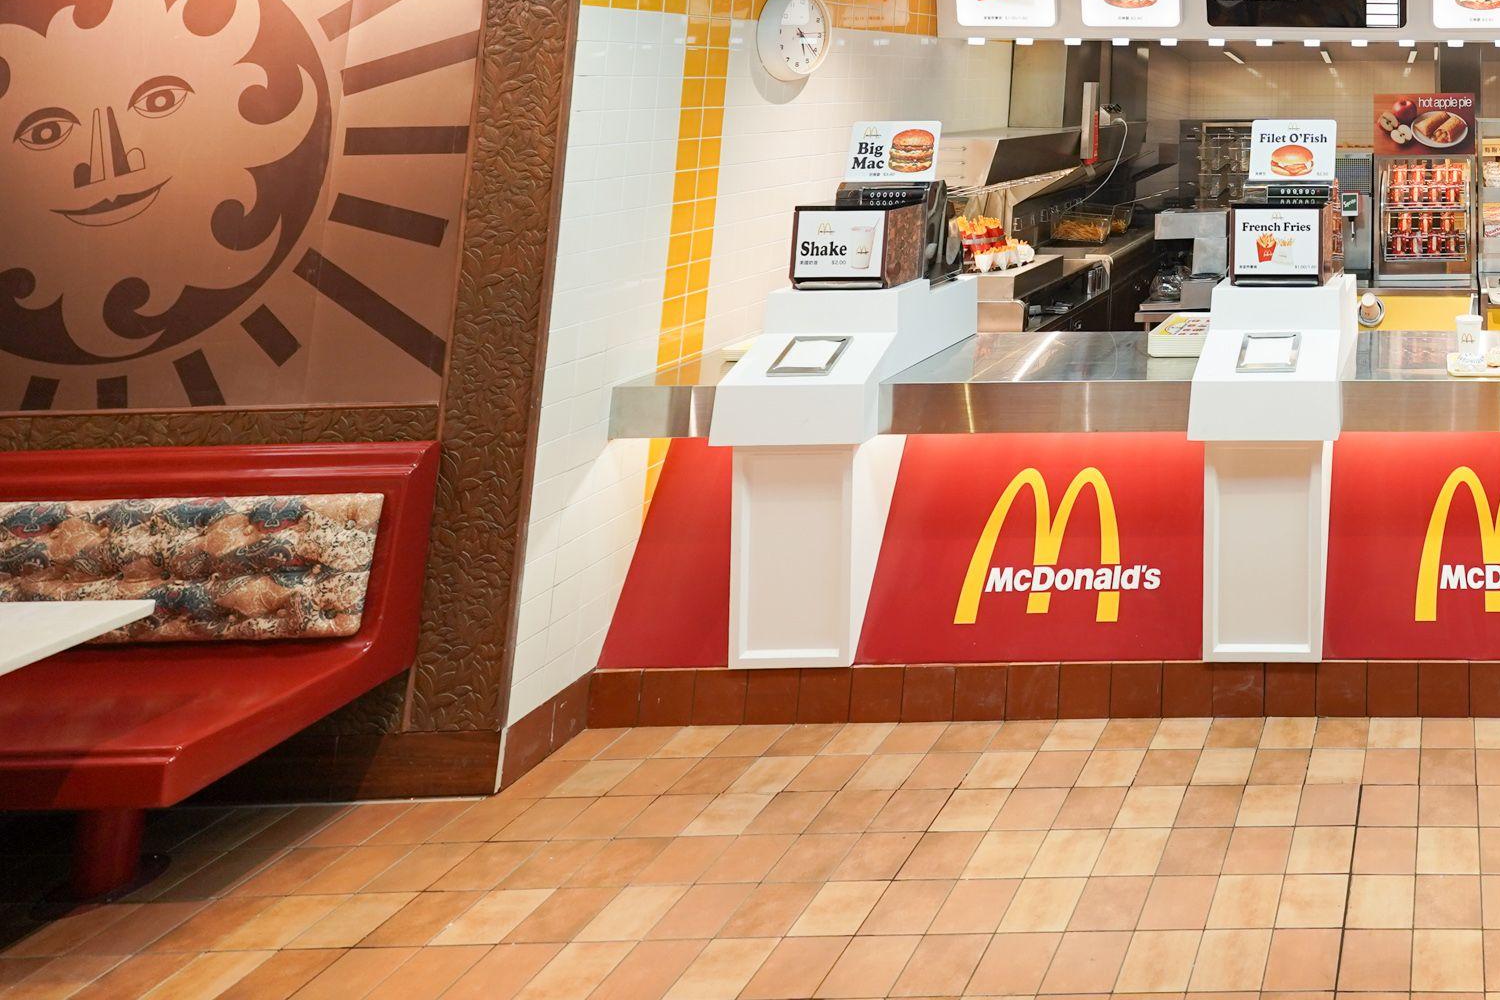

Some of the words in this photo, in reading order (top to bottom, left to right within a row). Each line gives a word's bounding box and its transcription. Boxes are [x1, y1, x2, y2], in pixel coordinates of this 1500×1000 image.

[1418, 96, 1433, 108] hot
[1433, 97, 1457, 109] apple
[1459, 96, 1472, 109] pie
[1260, 133, 1286, 143] Filet
[1290, 133, 1328, 143] O'Fish
[857, 142, 884, 157] Big
[851, 157, 885, 169] Mac
[1242, 222, 1280, 232] French
[1283, 222, 1311, 232] Fries
[800, 241, 847, 257] Shake
[984, 565, 1161, 592] McDonald's
